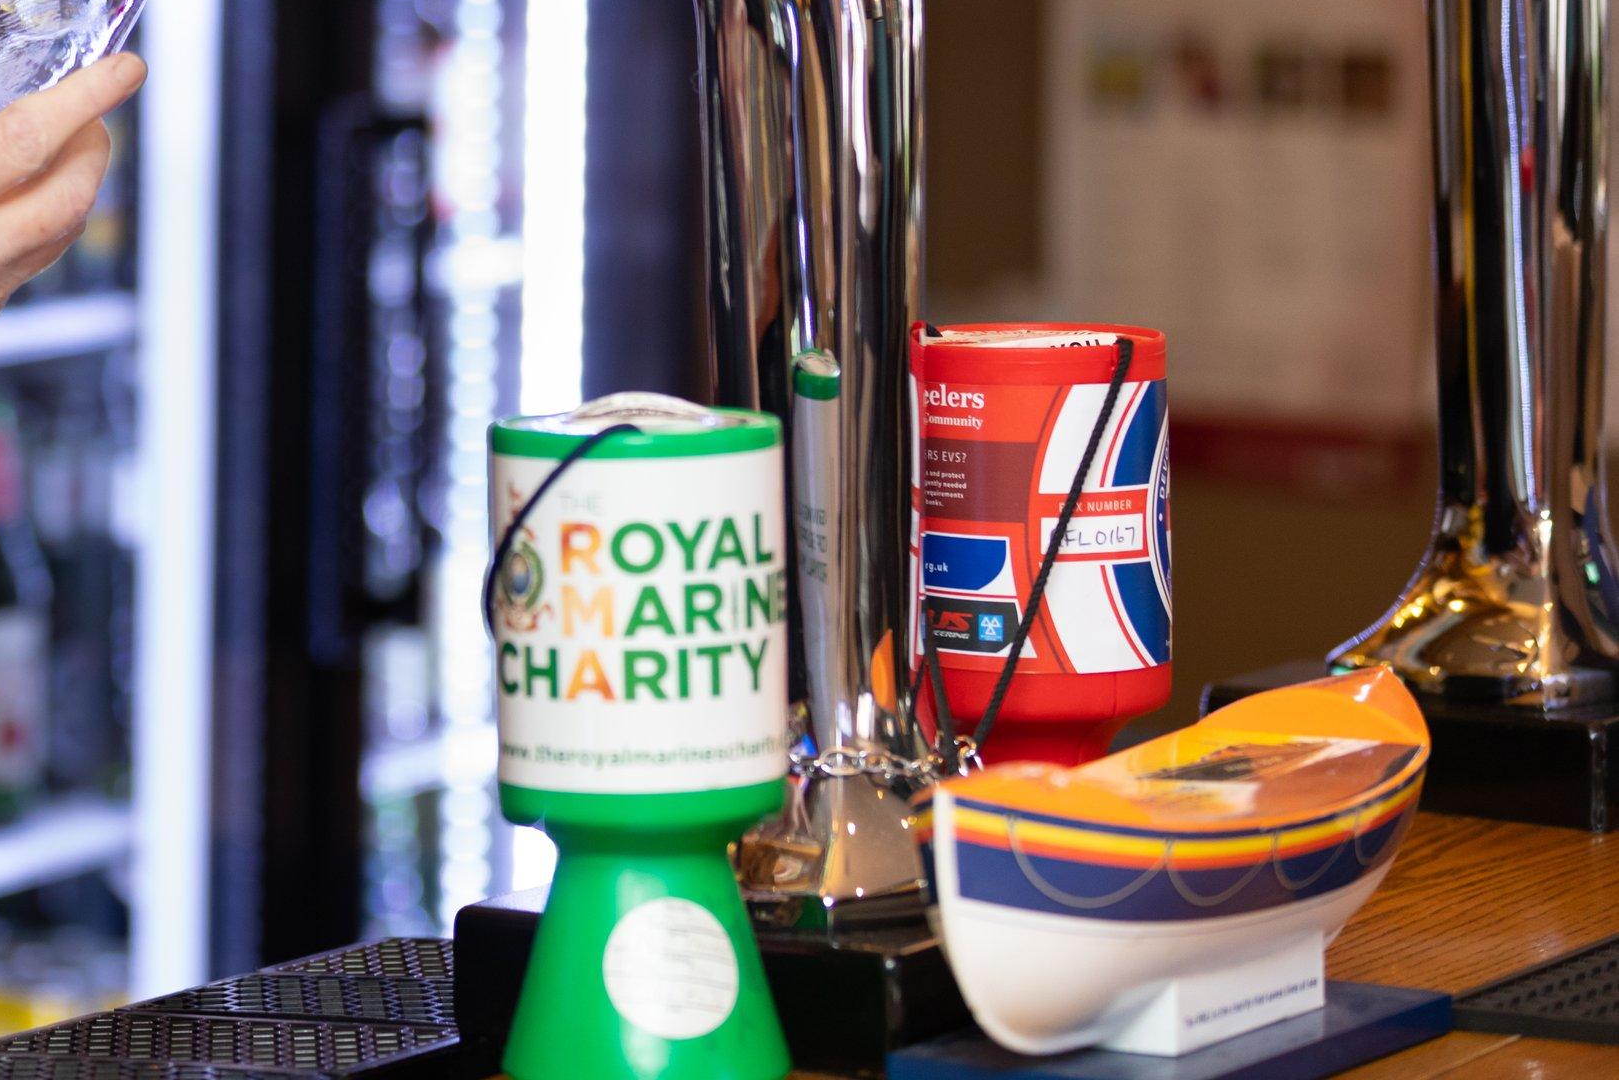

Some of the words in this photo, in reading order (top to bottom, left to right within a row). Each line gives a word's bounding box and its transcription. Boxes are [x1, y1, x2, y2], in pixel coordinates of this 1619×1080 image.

[942, 451, 967, 463] EVS?
[1087, 500, 1132, 512] NUMBER
[561, 513, 774, 575] ROYAL
[500, 640, 769, 701] CHARITY
